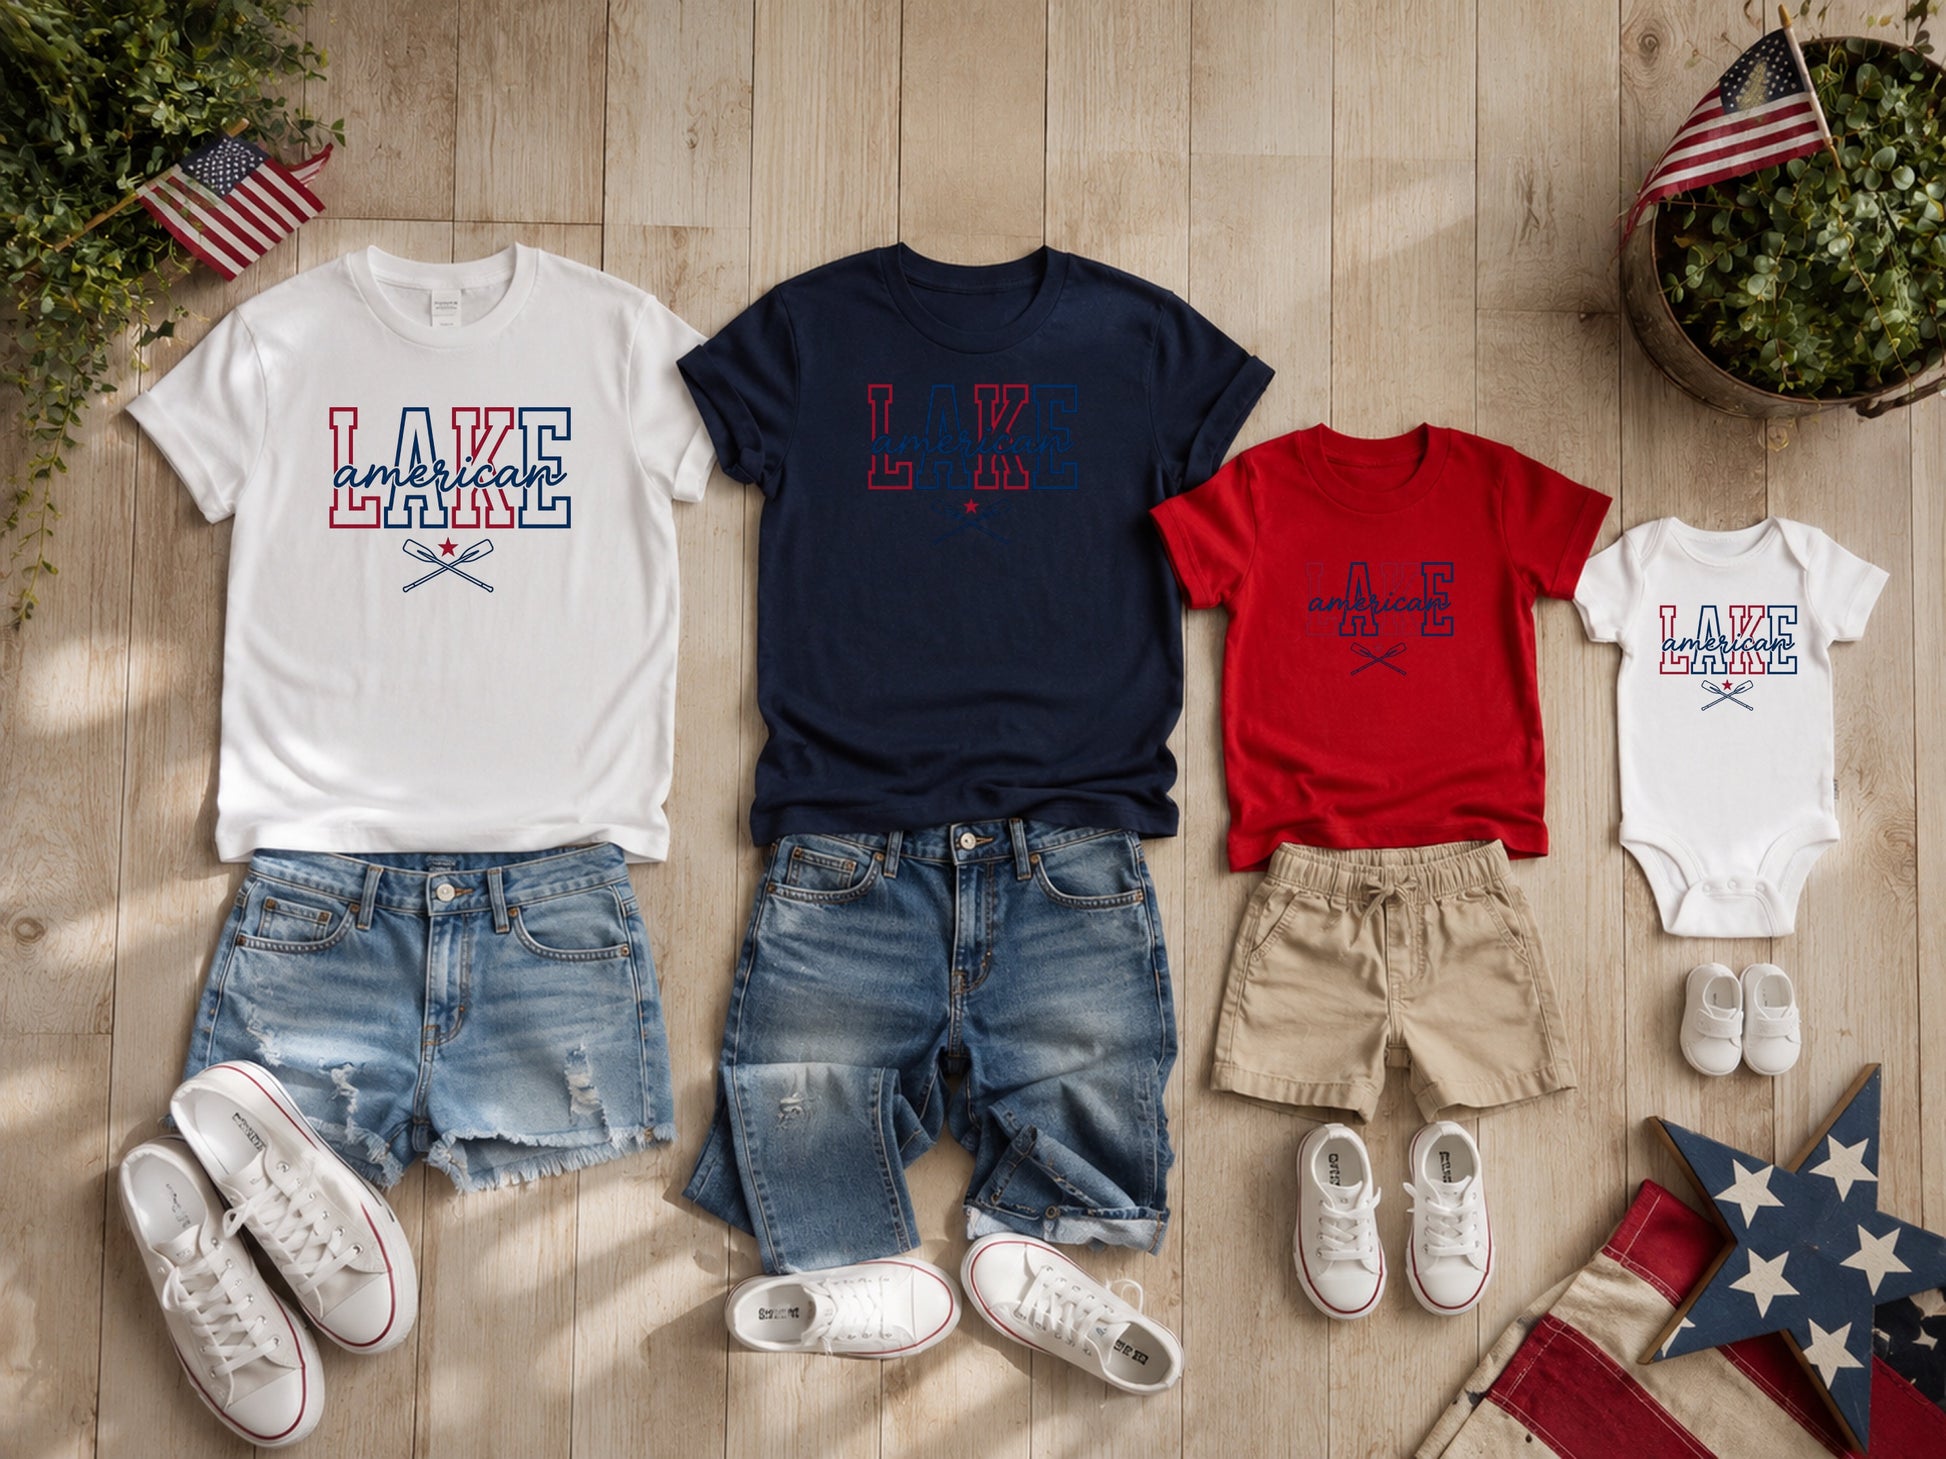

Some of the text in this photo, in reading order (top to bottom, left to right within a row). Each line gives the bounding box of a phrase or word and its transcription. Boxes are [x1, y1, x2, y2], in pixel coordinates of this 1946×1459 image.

[868, 384, 1078, 490] LAKE
[872, 427, 1075, 458] american
[329, 407, 571, 529] LAKE
[333, 456, 567, 492] american
[1305, 562, 1454, 637] LAKE
[1308, 592, 1451, 615] american
[1659, 605, 1797, 675] LAKE
[1661, 633, 1796, 653] american
